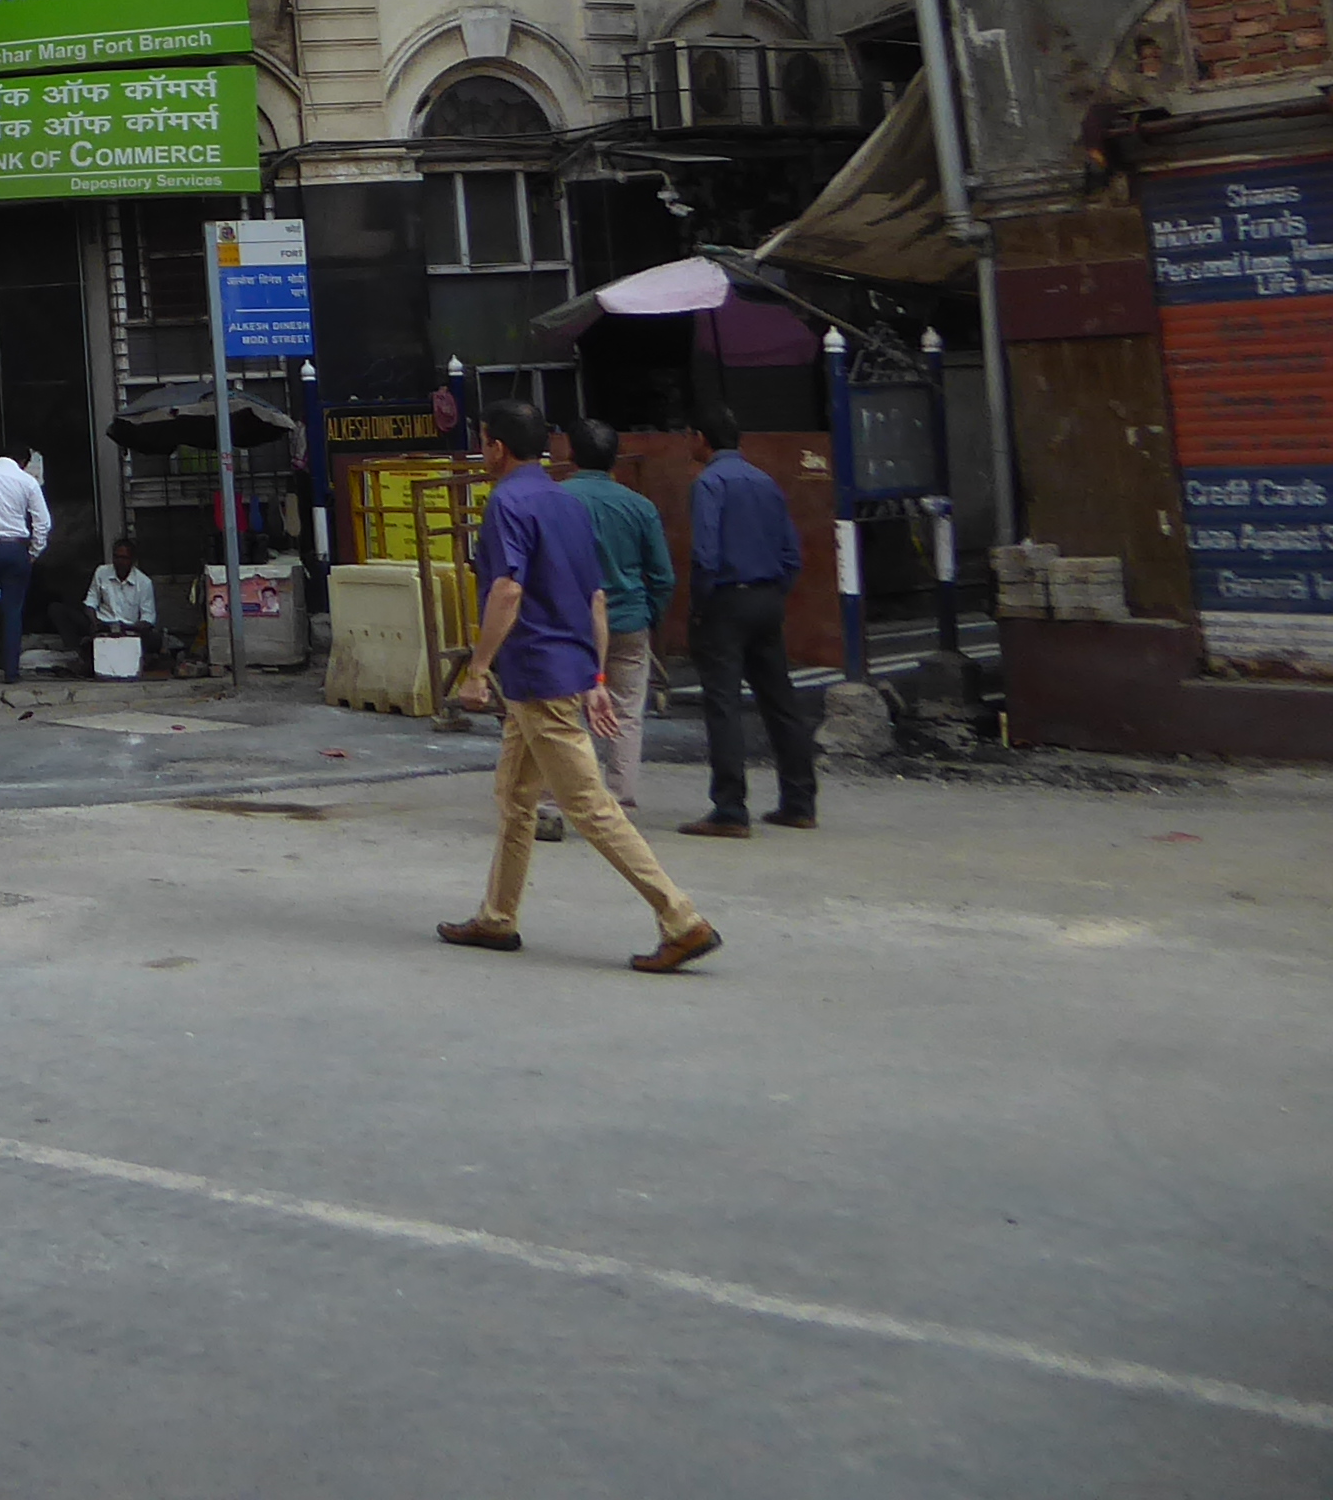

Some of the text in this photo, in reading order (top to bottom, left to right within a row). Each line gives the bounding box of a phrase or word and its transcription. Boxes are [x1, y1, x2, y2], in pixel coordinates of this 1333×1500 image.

[38, 41, 86, 61] Marg
[93, 36, 133, 56] Fort
[140, 30, 212, 50] Branch
[120, 71, 218, 100] कॉमर्स
[122, 103, 219, 132] कॉमर्स
[30, 149, 62, 169] OF
[70, 140, 222, 167] COMMERCE
[70, 173, 222, 191] Depository Services
[1152, 210, 1307, 248] Mutual Funds
[280, 249, 303, 258] FORT
[1156, 251, 1243, 283] Personal
[1256, 272, 1298, 295] Life
[228, 321, 310, 332] ALKESH DINESH
[242, 334, 310, 344] MODI STREET
[327, 416, 371, 441] ALKESH
[371, 415, 412, 439] DINESH
[1186, 478, 1328, 506] Credit Cards
[1184, 524, 1237, 550] Loan
